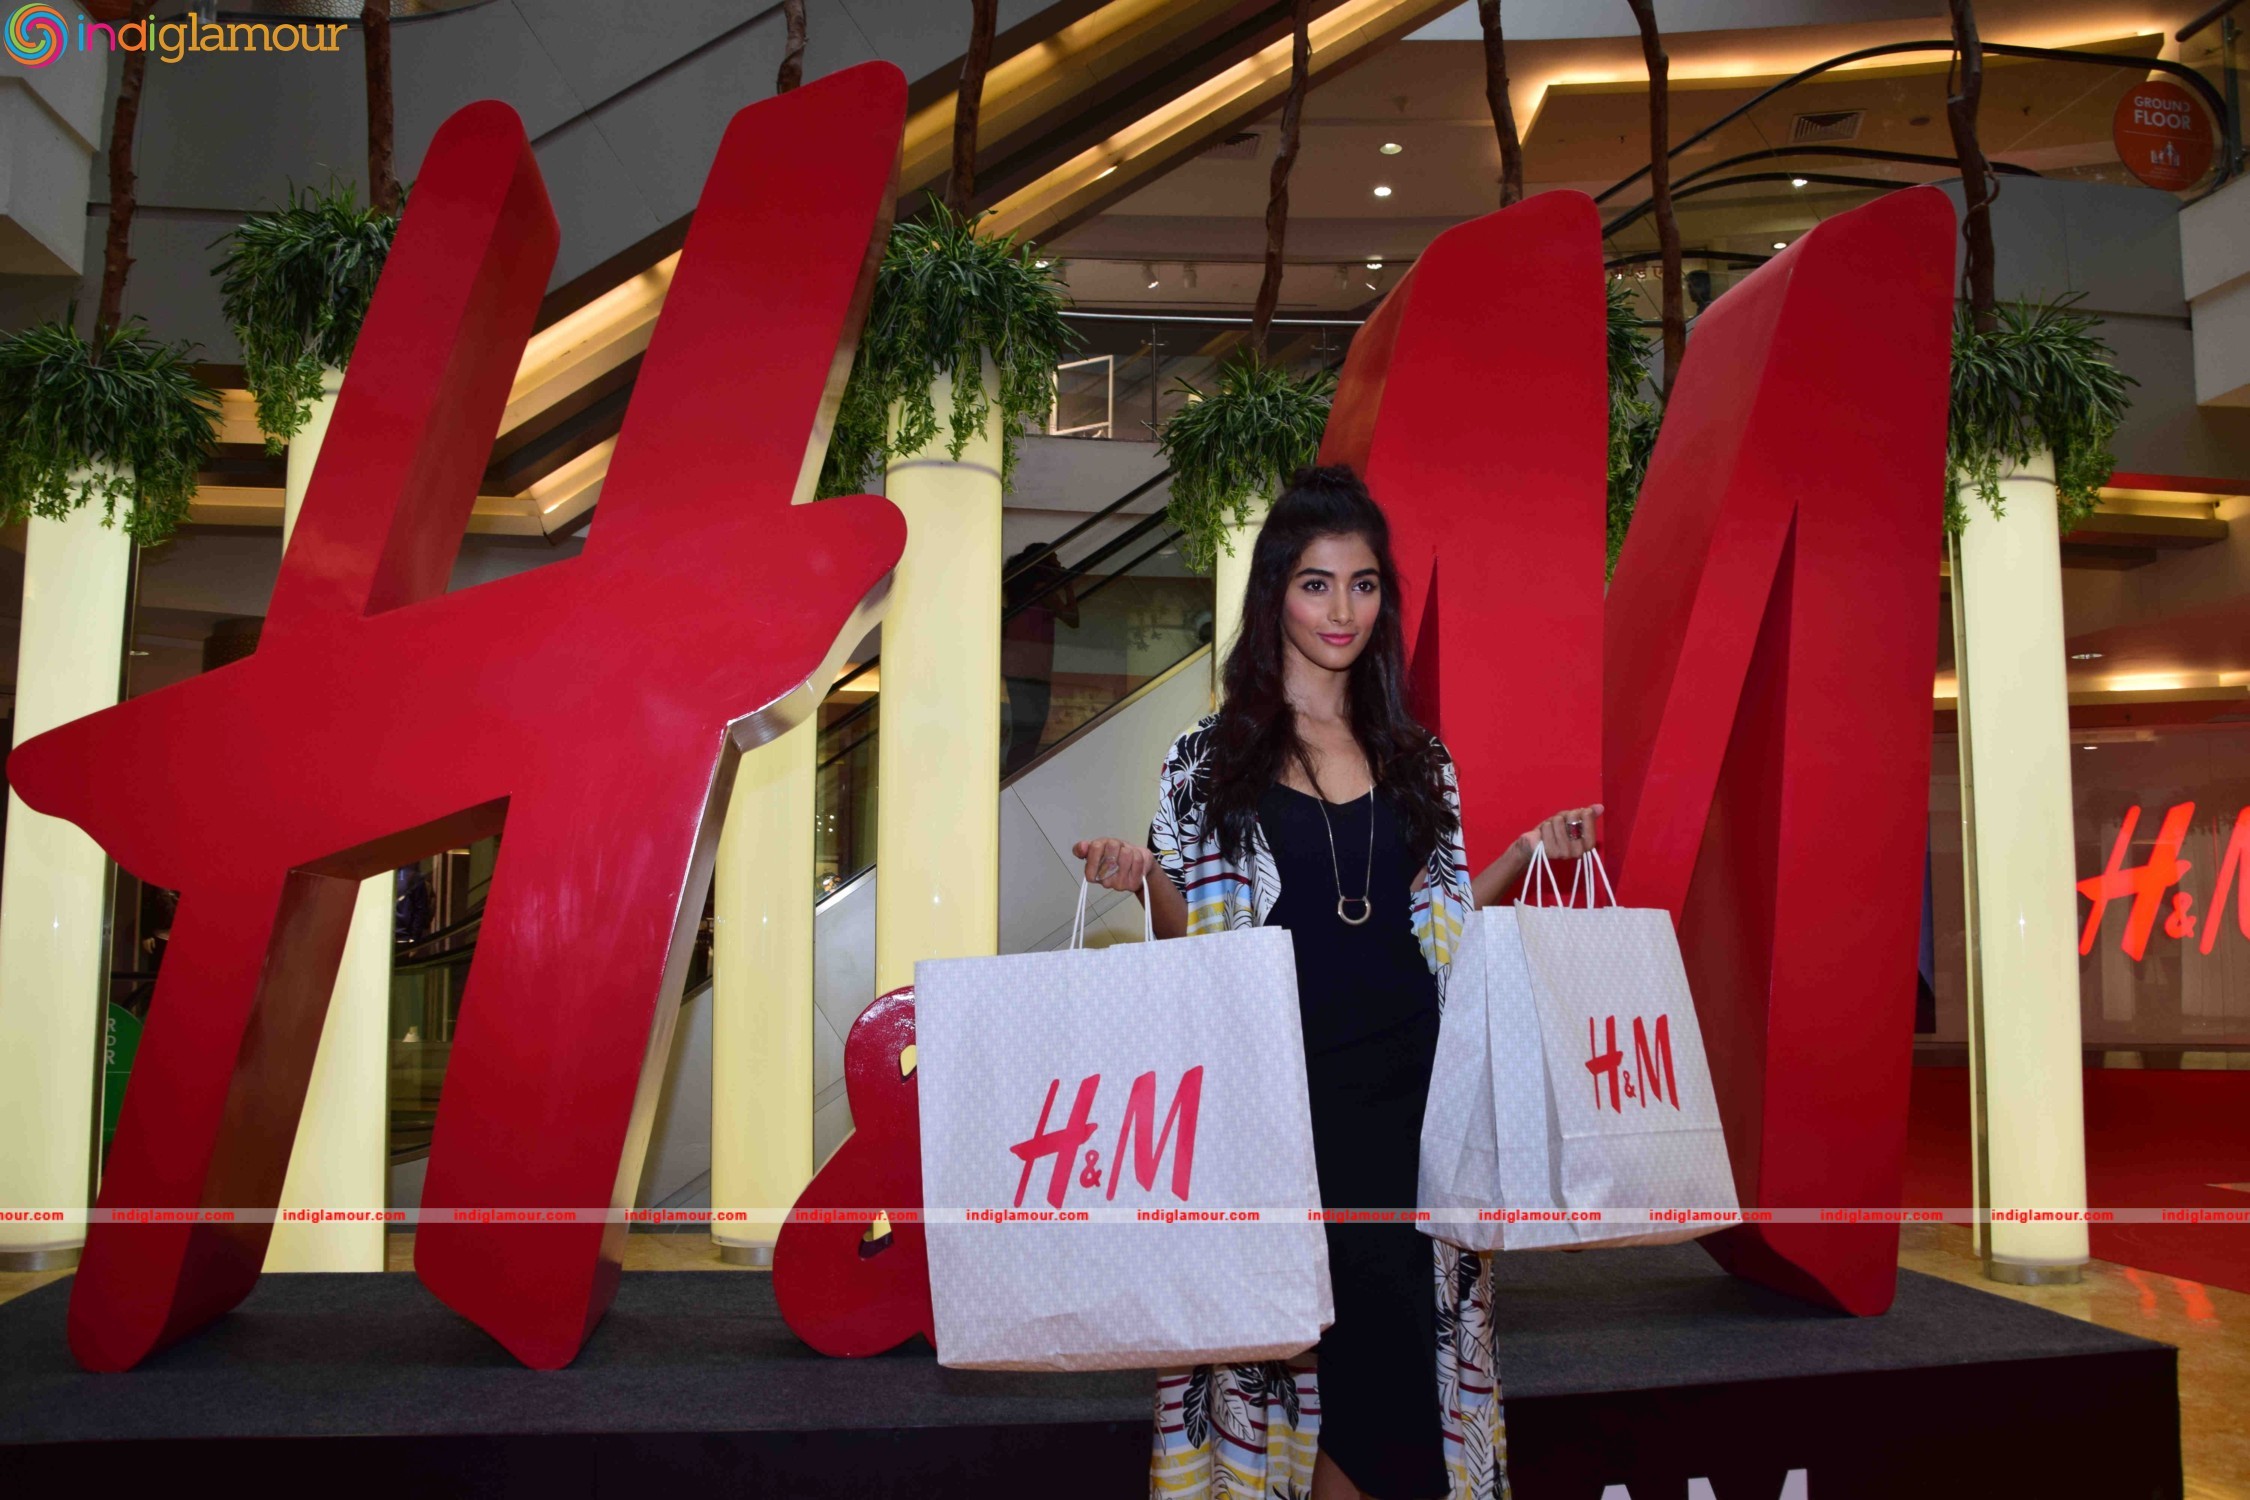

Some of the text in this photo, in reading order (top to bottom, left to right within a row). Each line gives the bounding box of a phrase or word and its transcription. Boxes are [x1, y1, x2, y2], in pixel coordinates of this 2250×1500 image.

[2134, 95, 2190, 113] GROUND
[2134, 109, 2191, 130] FLOOR
[1585, 1014, 1680, 1114] H&M
[1010, 1065, 1204, 1210] H&M
